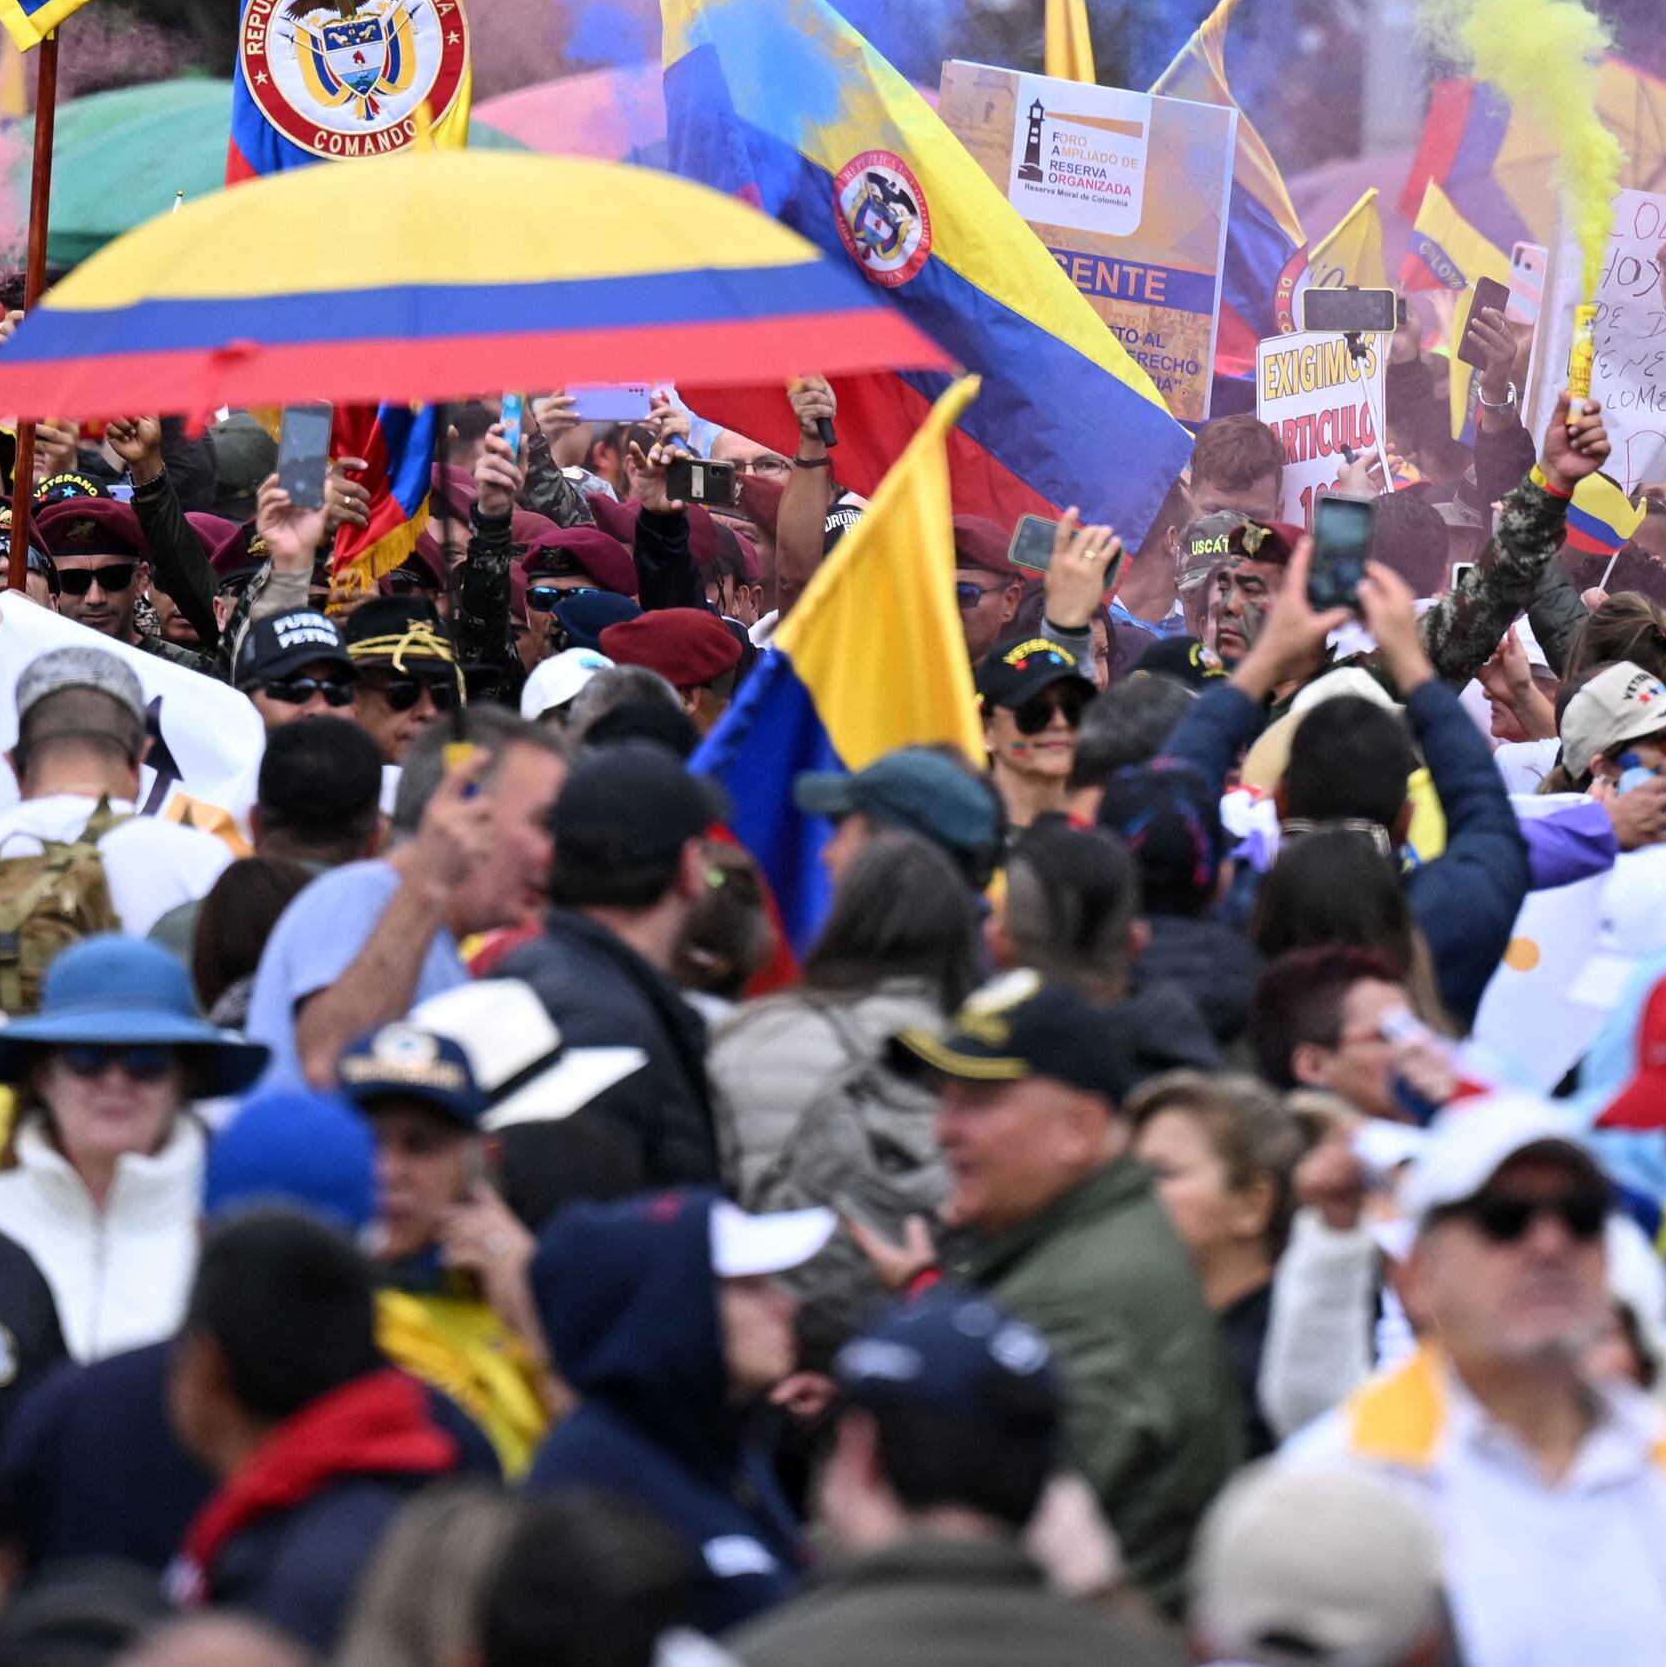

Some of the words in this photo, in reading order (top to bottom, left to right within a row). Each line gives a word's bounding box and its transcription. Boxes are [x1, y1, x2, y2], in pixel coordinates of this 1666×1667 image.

[314, 119, 418, 156] COMANDO
[1053, 132, 1087, 147] FORO
[1050, 160, 1107, 180] RESERVA
[1122, 157, 1139, 169] DE
[1024, 183, 1055, 195] Reserva
[1057, 189, 1078, 199] Moral
[1080, 192, 1090, 201] de
[1091, 194, 1128, 207] Colombia
[1048, 173, 1132, 197] ORGANIZADA
[1143, 333, 1166, 349] AL
[33, 474, 98, 498] VETERANO
[1192, 534, 1229, 555] USCÁT
